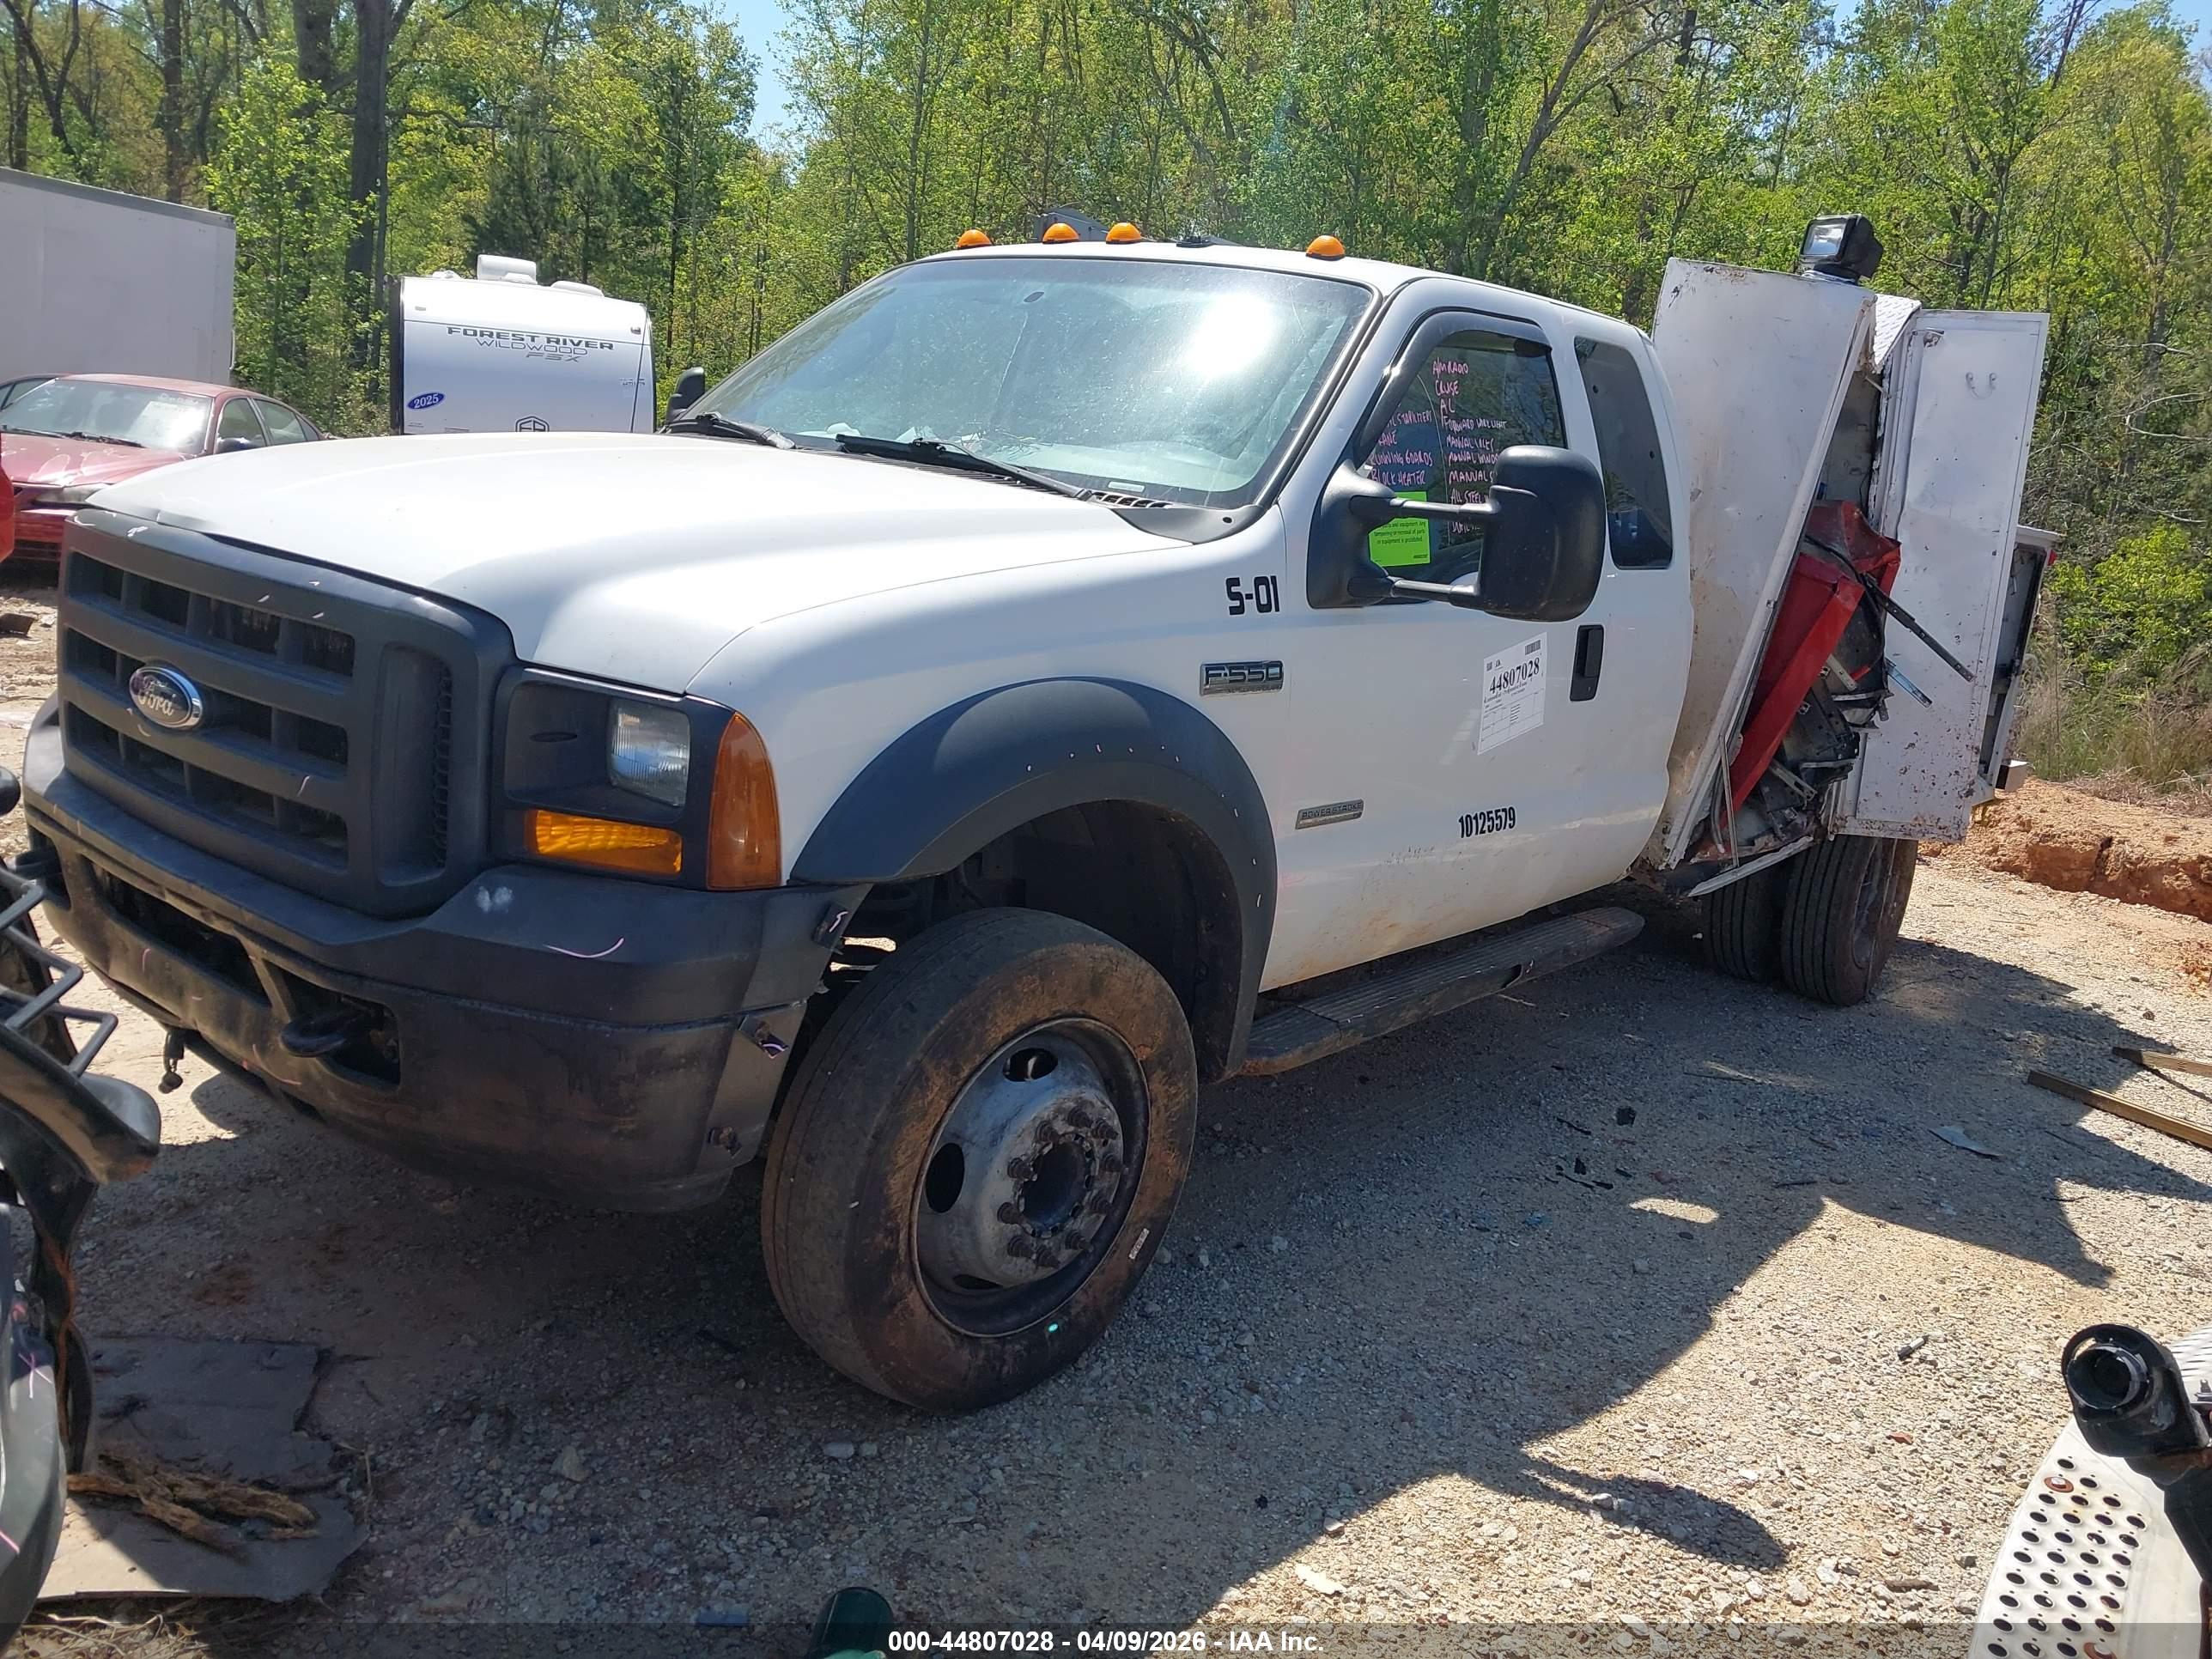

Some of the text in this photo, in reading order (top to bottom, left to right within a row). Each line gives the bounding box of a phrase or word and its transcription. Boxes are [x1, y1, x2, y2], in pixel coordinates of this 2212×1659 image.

[447, 326, 614, 350] FOREST RIVER
[476, 338, 588, 356] WILDWOOD
[526, 352, 582, 363] FSX
[414, 393, 439, 409] 2025
[1449, 470, 1488, 485] MANUAL
[1225, 575, 1280, 616] S-01
[1204, 661, 1284, 686] F-550
[1489, 657, 1540, 695] 44807028
[1458, 806, 1516, 839] 10125579
